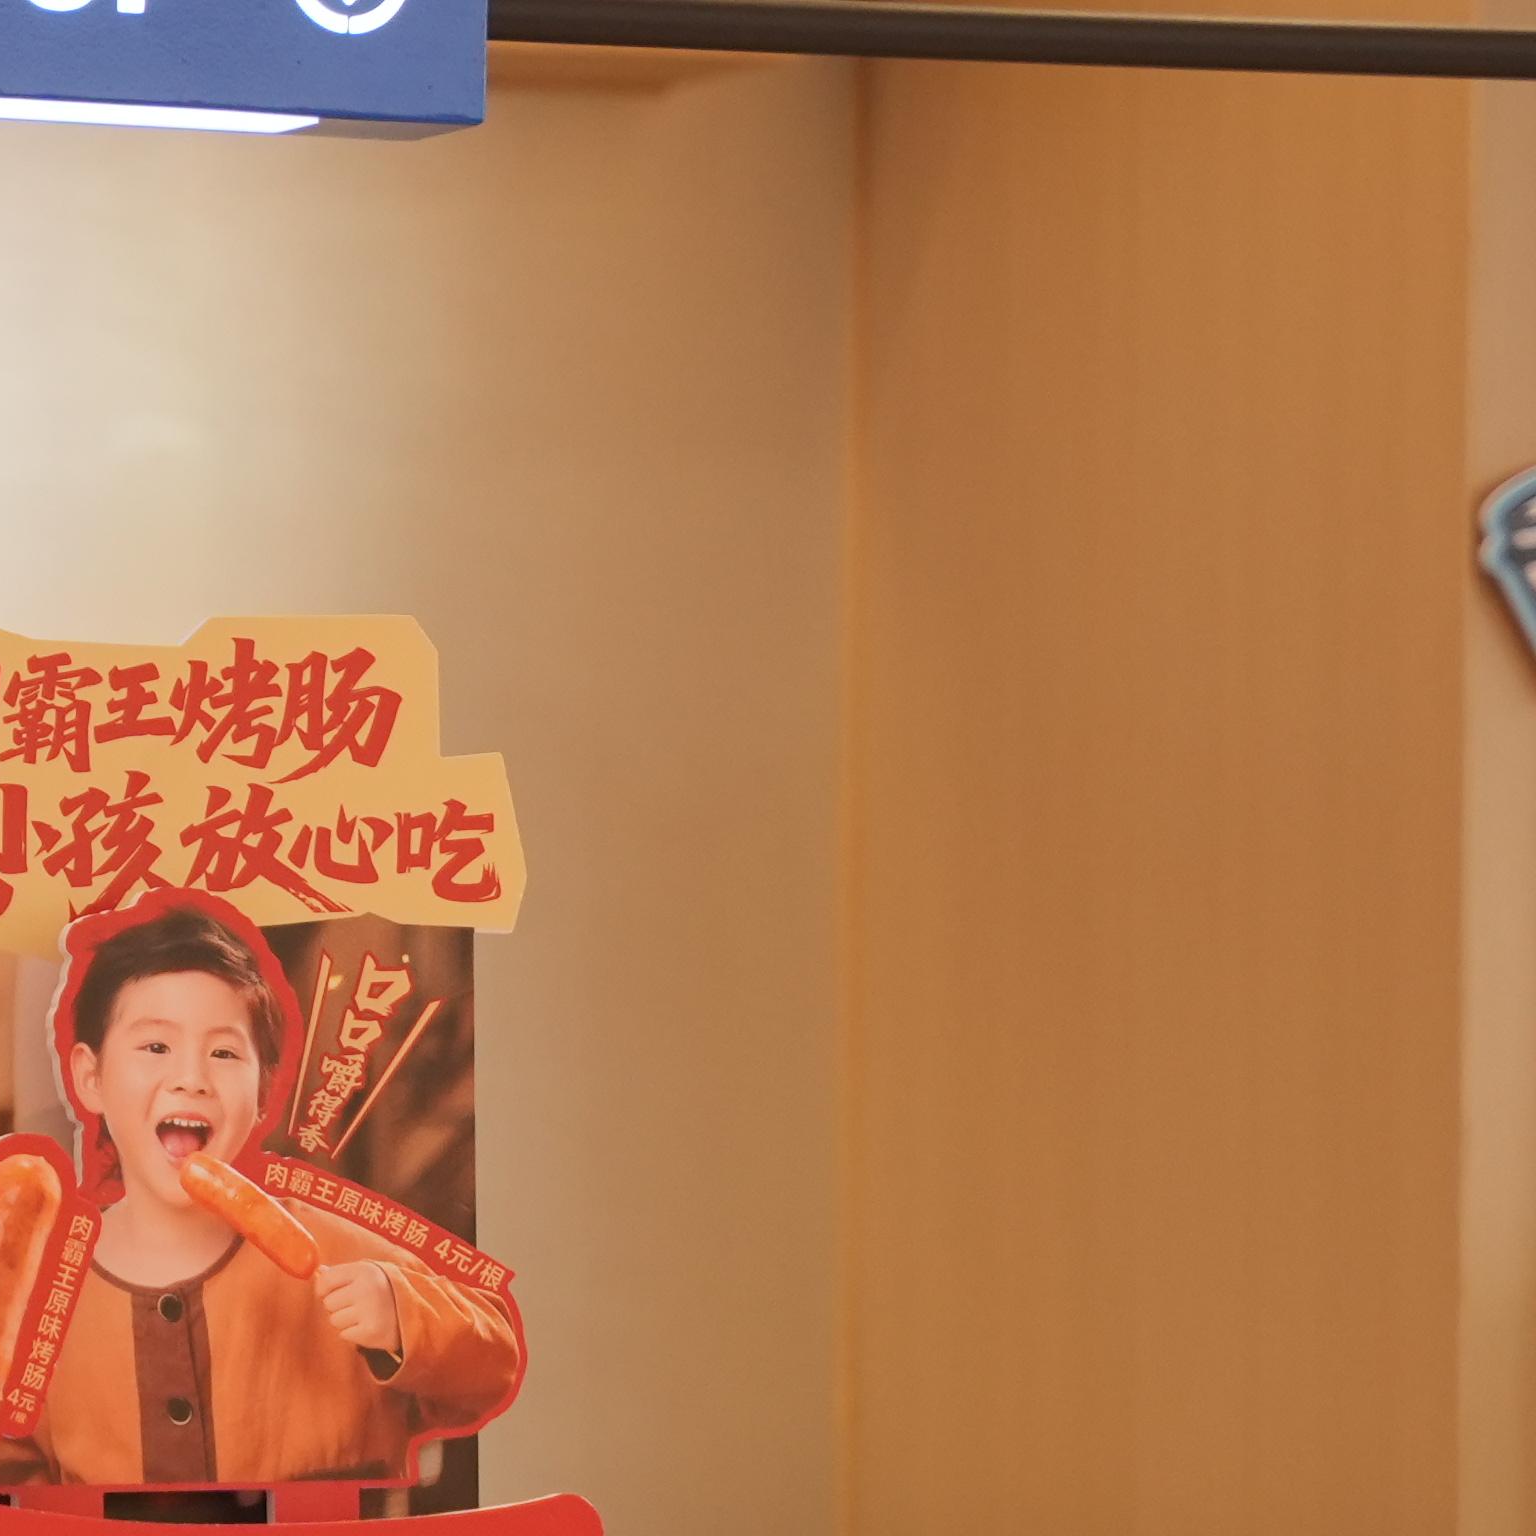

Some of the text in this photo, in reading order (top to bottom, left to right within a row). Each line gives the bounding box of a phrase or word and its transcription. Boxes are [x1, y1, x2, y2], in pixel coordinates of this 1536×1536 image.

[298, 954, 411, 1153] 口口嚼得香
[21, 1215, 93, 1390] 肉霸王原味烤肠
[265, 1163, 506, 1292] 肉霸王原味烤肠 4元/根
